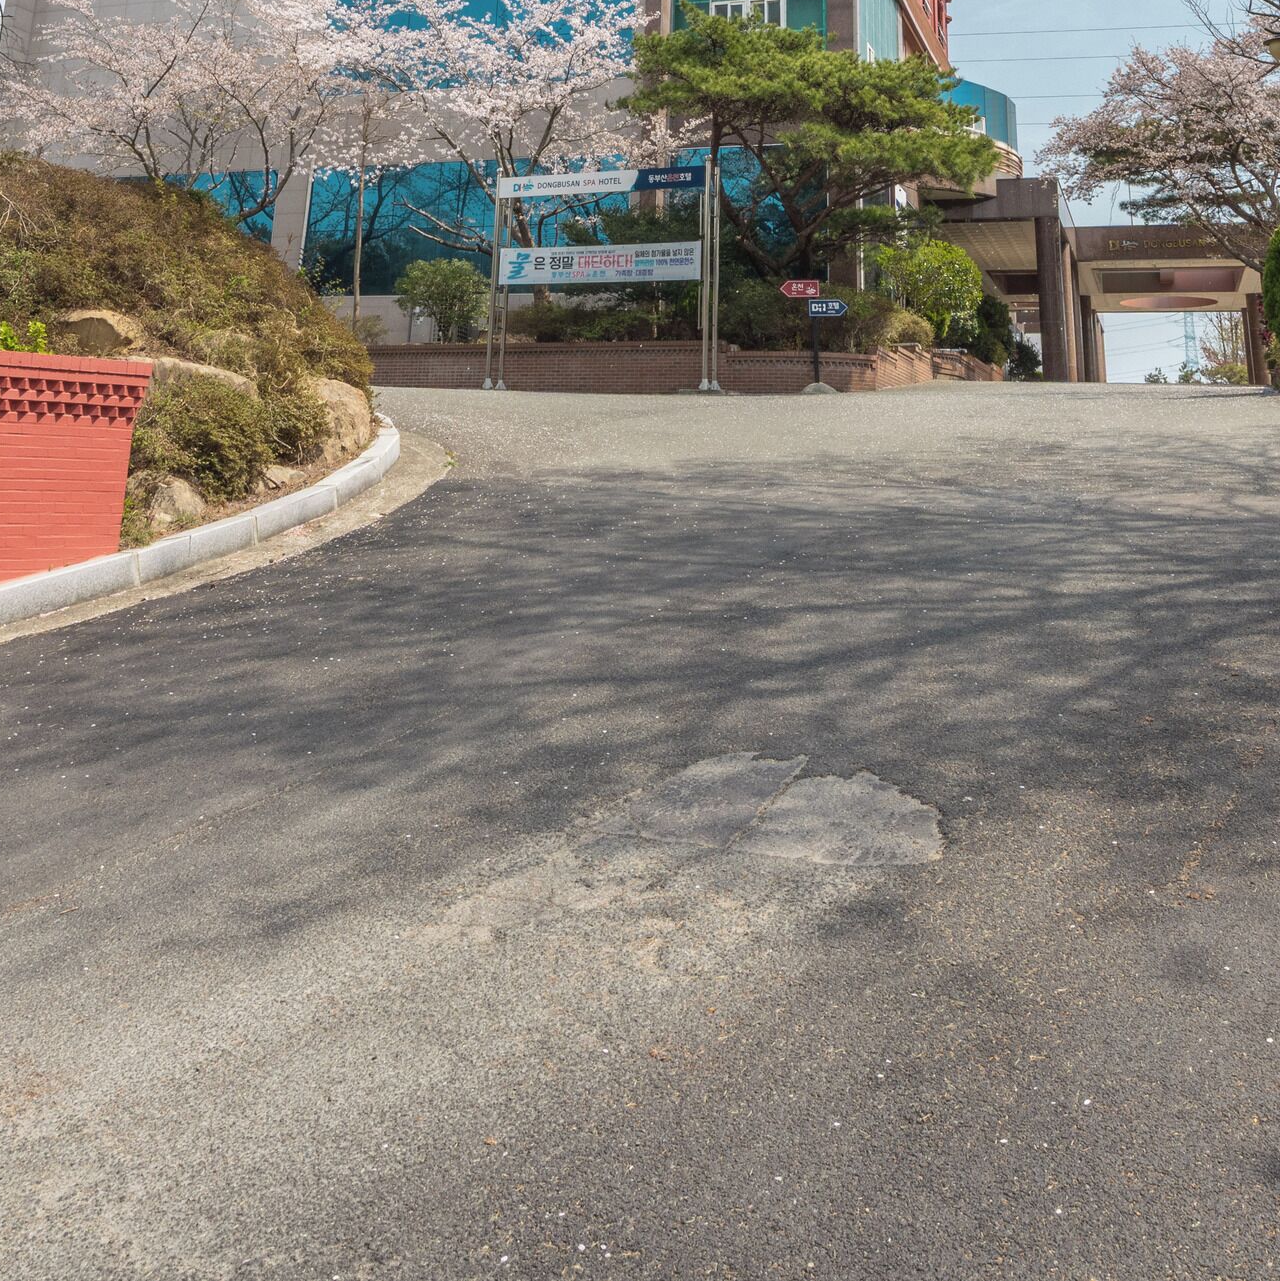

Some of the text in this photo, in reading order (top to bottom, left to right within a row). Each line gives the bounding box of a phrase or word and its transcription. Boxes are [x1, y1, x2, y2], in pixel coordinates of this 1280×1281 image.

[537, 180, 580, 189] DONGBUSAN
[583, 179, 596, 187] SPA
[598, 177, 622, 186] HOTEL
[549, 256, 575, 270] 정말
[578, 254, 633, 269] 대단하다!
